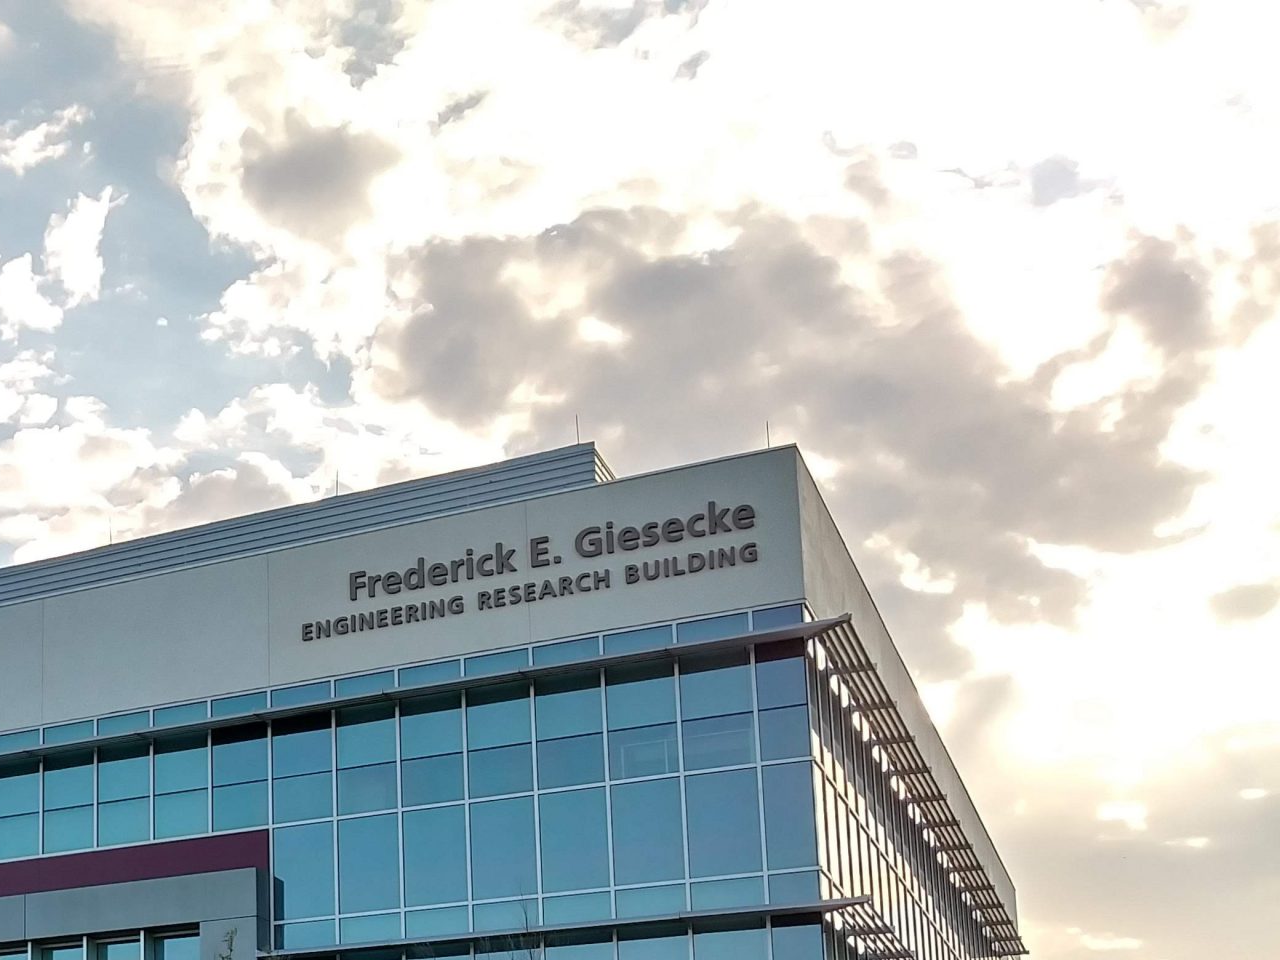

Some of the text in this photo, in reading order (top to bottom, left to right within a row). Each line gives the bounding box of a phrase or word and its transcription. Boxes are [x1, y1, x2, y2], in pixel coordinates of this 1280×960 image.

[301, 541, 759, 643] ENGINEERING RESEARCH BUILDING
[348, 500, 757, 602] Frederick E. Giesecke
